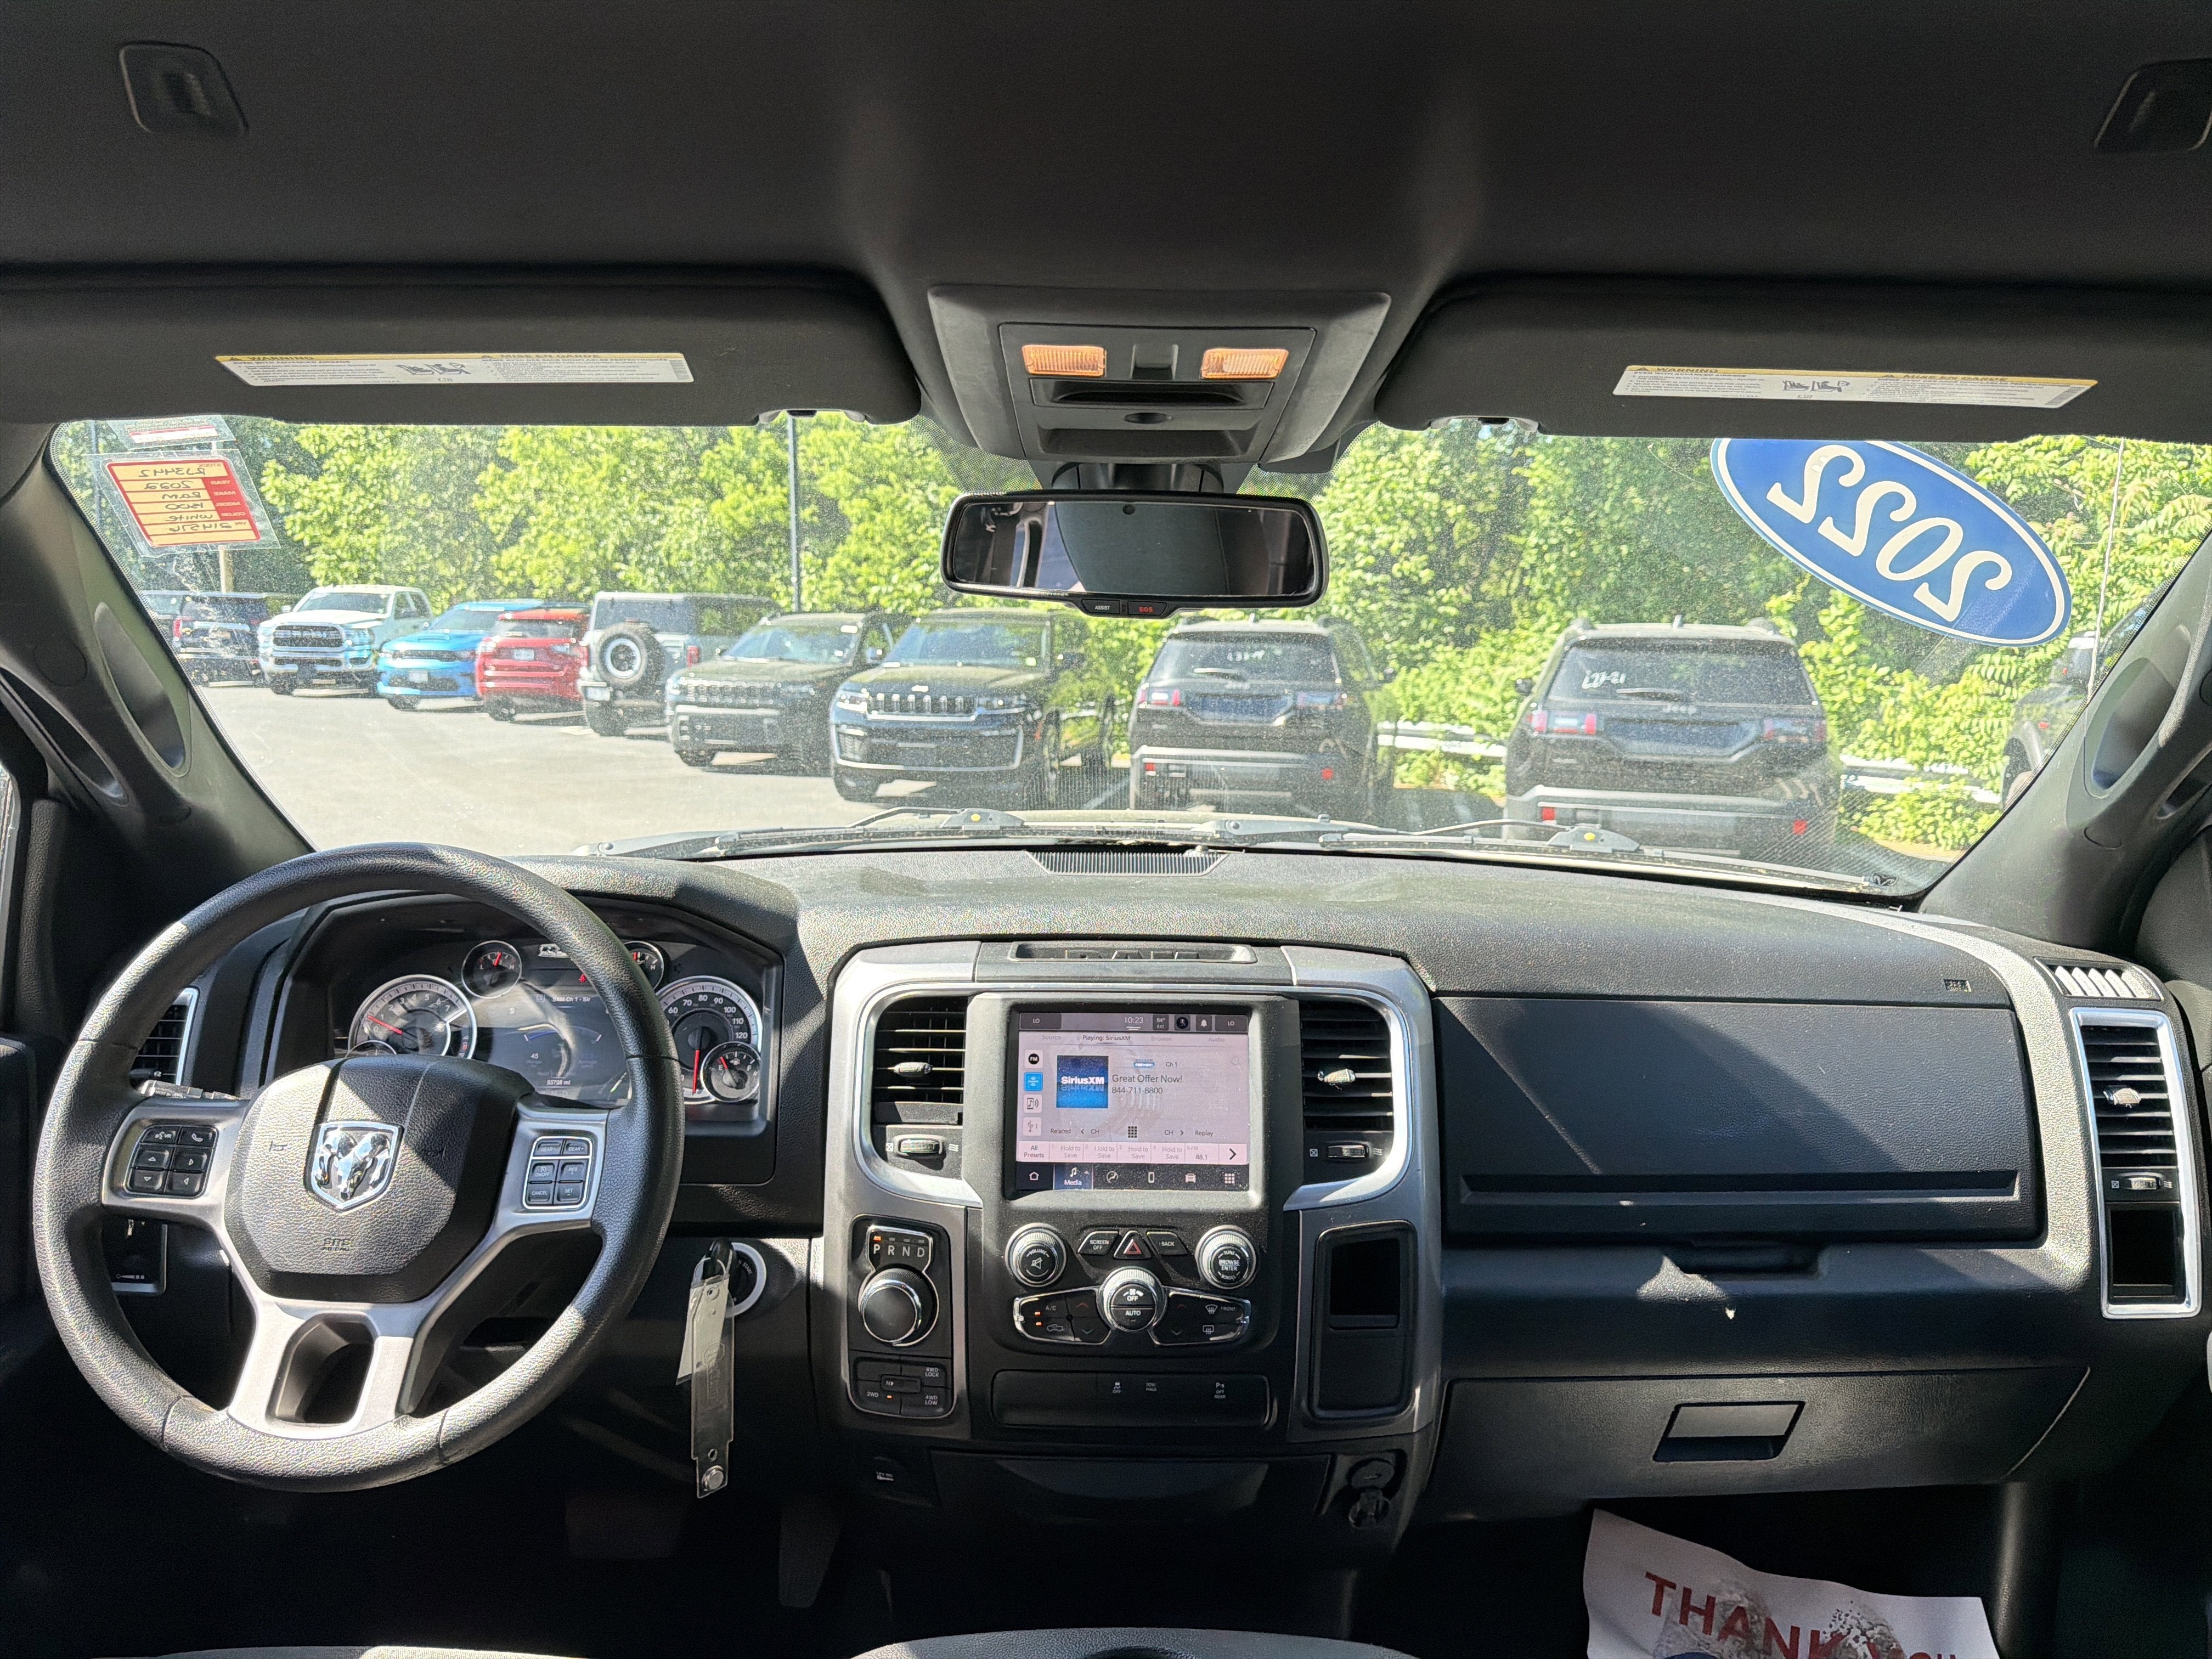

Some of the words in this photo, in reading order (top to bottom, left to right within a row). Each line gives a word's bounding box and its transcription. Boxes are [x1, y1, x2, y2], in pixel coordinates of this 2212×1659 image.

[1662, 704, 1697, 714] Jeep
[1061, 1076, 1104, 1084] SiriusXM
[1137, 1074, 1158, 1082] Offer
[873, 1244, 880, 1254] P
[888, 1245, 895, 1255] R
[902, 1246, 910, 1257] N
[917, 1247, 924, 1257] D
[1645, 1571, 1849, 1659] THANK
